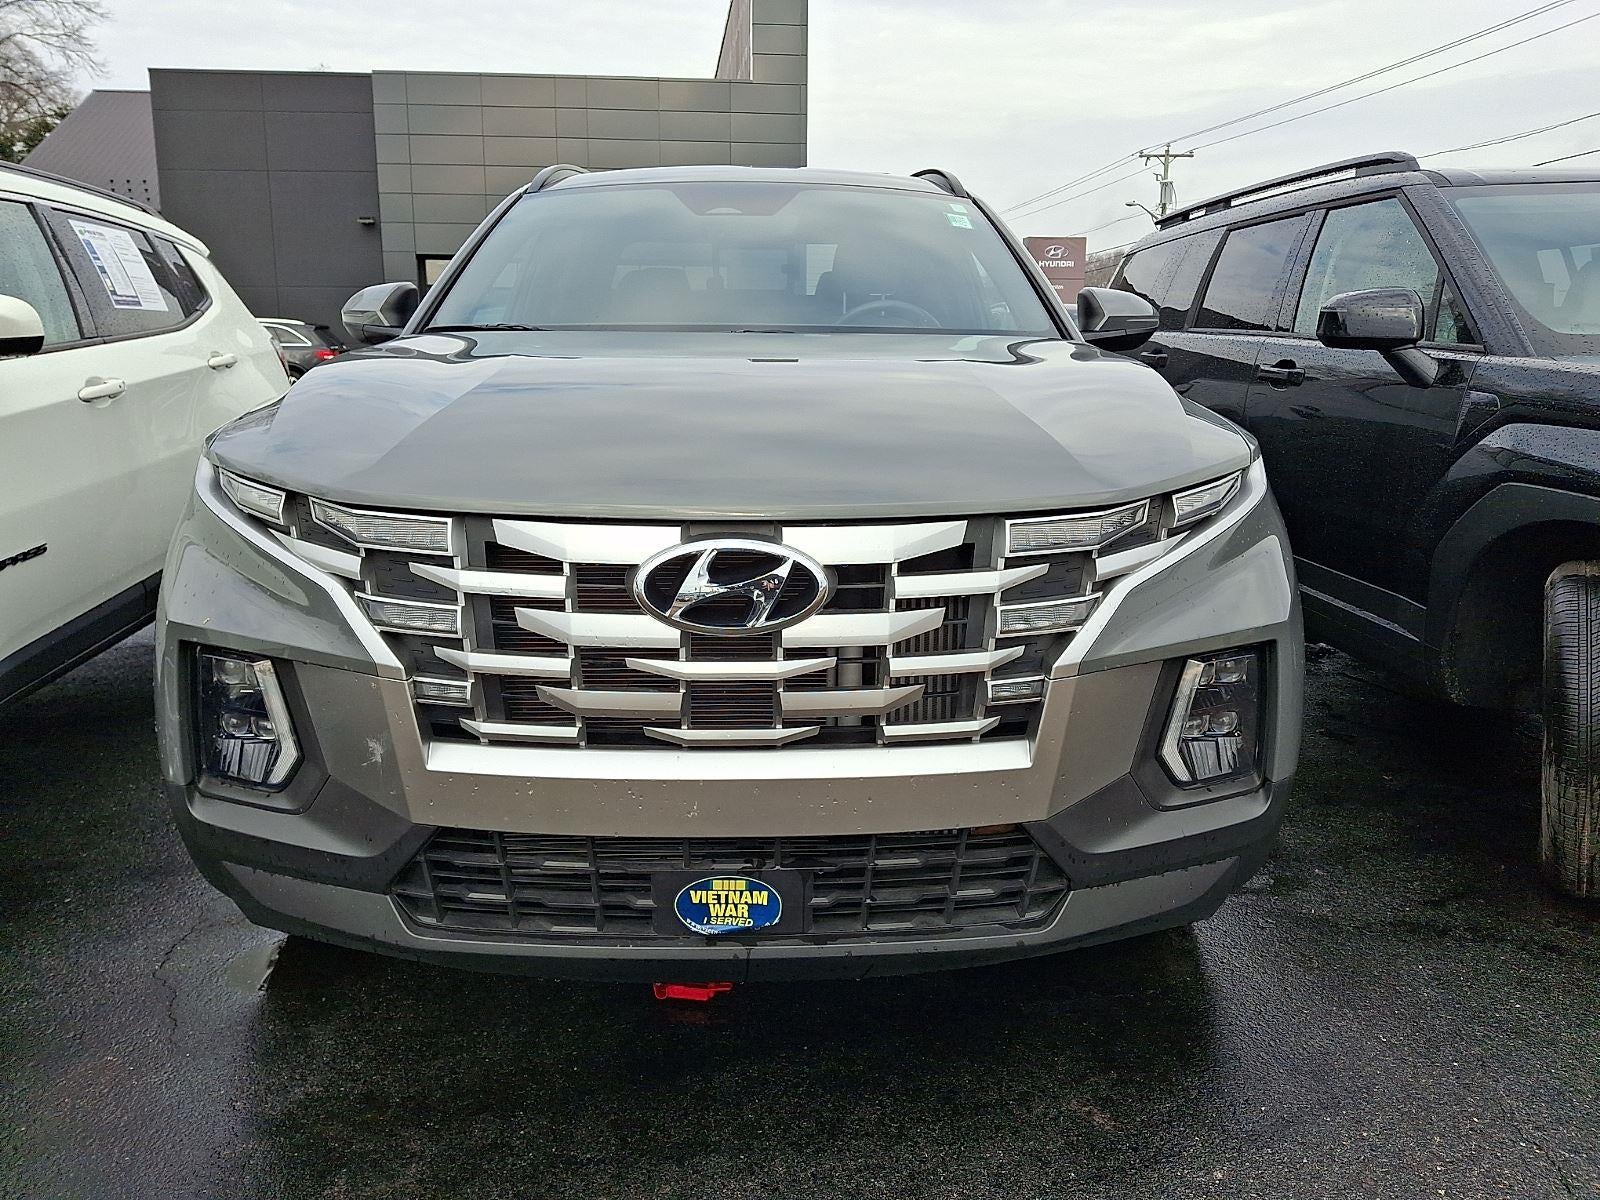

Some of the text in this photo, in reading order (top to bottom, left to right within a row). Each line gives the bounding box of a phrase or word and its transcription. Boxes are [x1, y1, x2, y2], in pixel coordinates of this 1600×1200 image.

[1038, 260, 1075, 268] HYUNDAI
[690, 890, 769, 906] VIETNAM
[709, 903, 749, 918] WAR
[709, 917, 754, 927] SERVED
